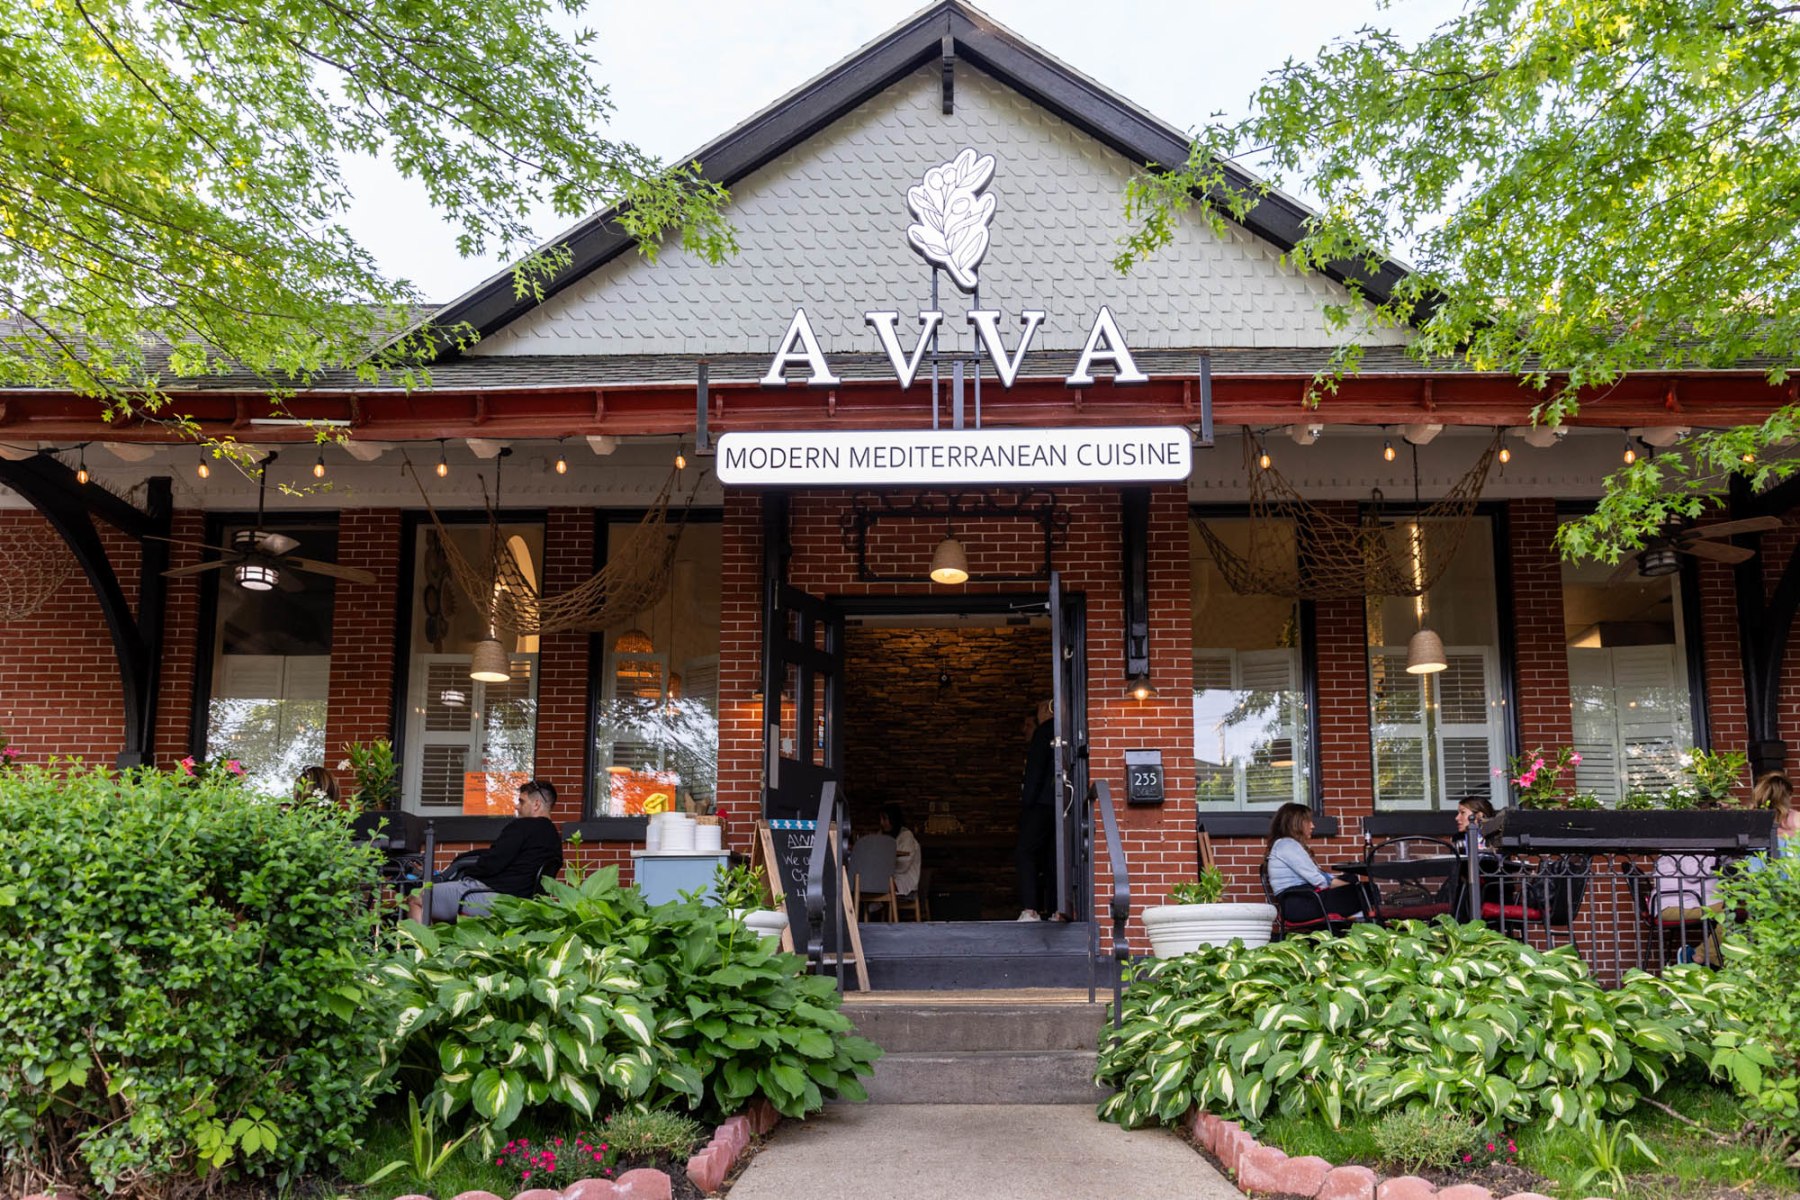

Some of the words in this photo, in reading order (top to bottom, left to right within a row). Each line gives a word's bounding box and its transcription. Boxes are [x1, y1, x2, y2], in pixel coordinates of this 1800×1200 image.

[759, 305, 1150, 389] AVVA
[725, 447, 839, 469] MODERN
[850, 445, 1067, 468] MEDITERRANEAN
[1077, 443, 1182, 466] CUISINE
[1134, 772, 1157, 786] 235
[782, 851, 800, 866] We
